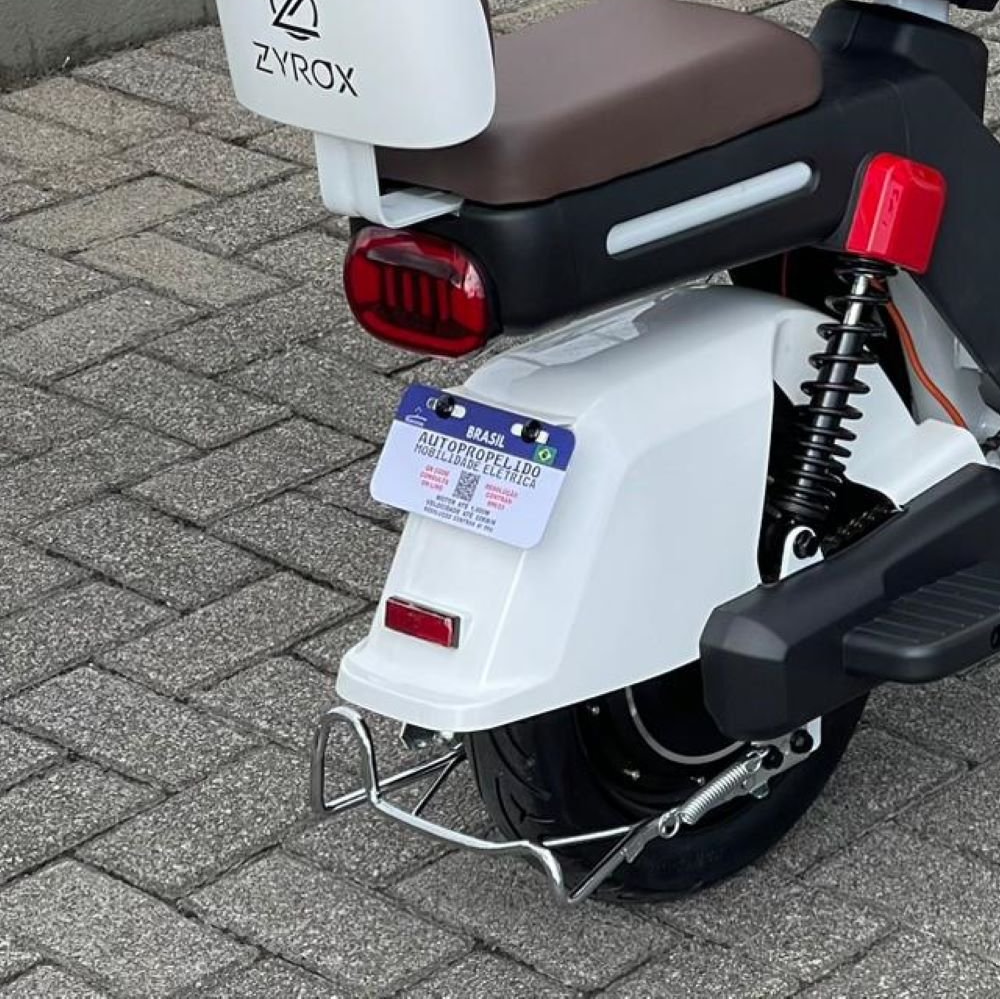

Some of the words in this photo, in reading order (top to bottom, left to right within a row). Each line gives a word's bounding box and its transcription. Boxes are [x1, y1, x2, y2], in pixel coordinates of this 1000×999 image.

[252, 41, 358, 97] ZYROX
[418, 431, 541, 478] AUTOPROPELIDO
[466, 424, 505, 448] BRASIL
[414, 443, 480, 471] MOBILIDADE
